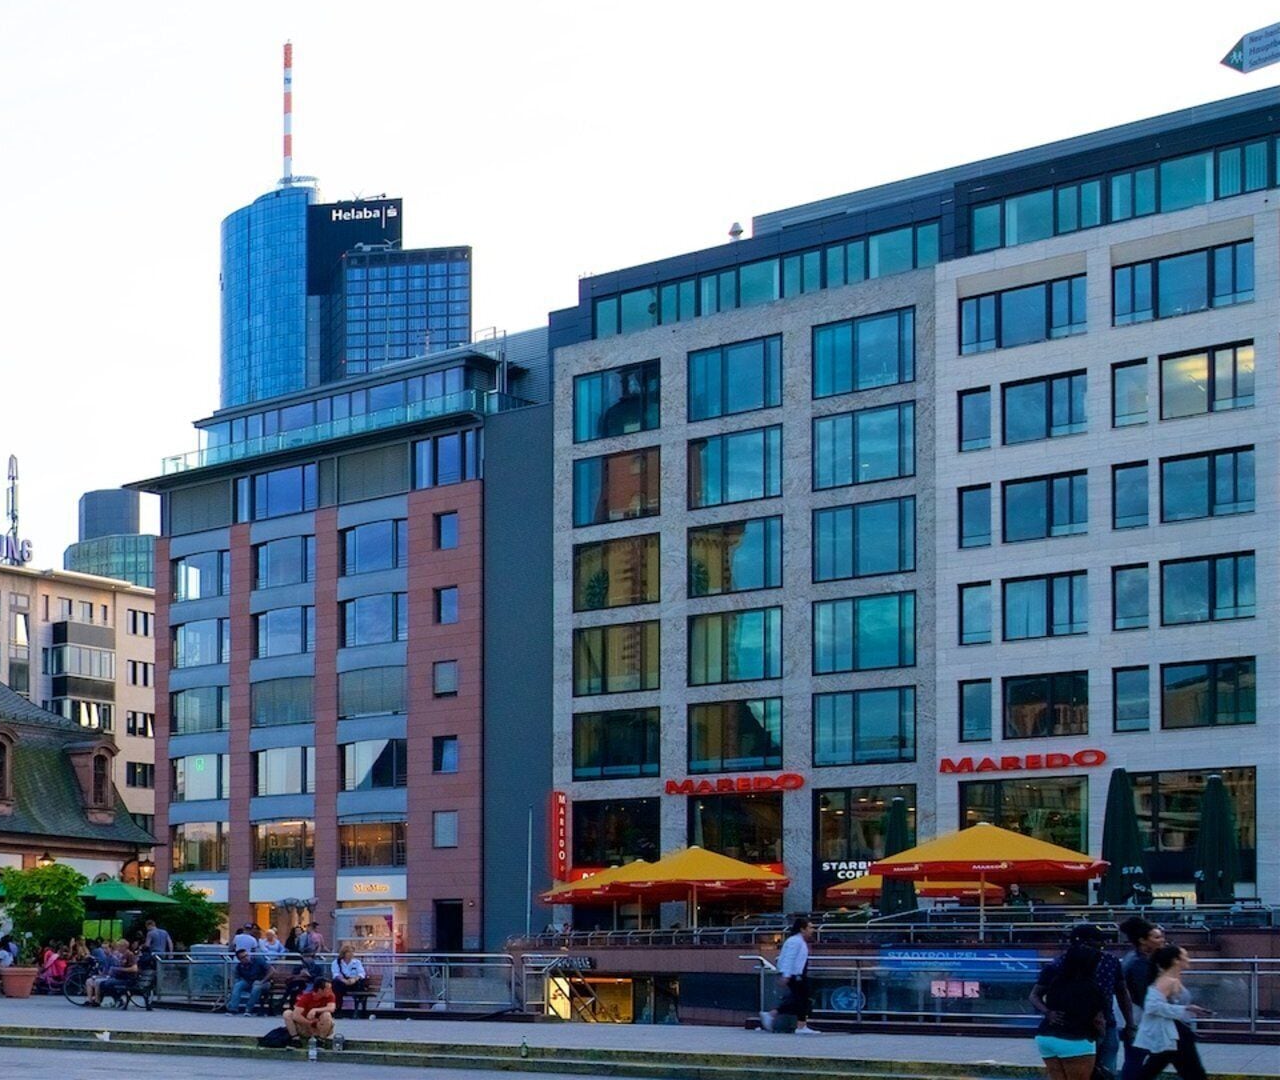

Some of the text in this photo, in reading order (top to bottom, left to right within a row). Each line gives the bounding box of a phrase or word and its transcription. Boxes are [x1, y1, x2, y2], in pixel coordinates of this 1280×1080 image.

[332, 207, 380, 221] Helaba
[940, 749, 1106, 773] MAREDO
[665, 773, 804, 795] MAREDO
[558, 794, 566, 860] MAREDO
